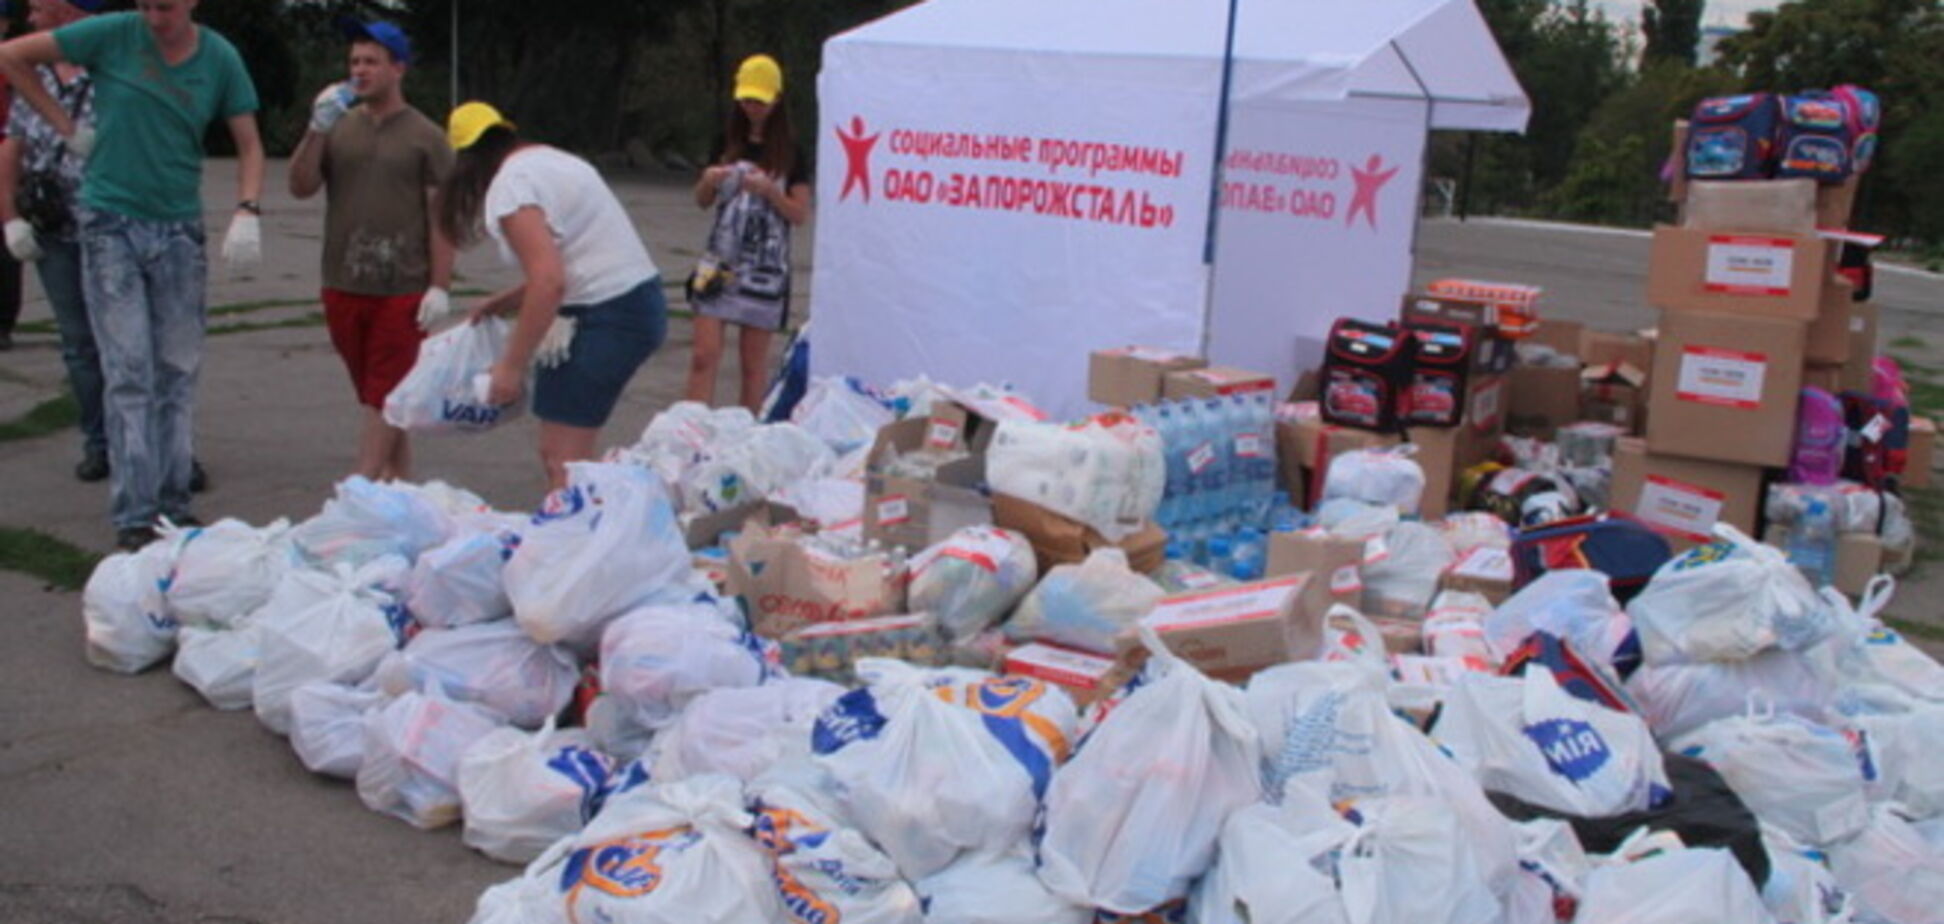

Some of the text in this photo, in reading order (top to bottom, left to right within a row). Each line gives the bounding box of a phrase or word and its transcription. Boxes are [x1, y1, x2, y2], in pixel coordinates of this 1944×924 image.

[888, 128, 1184, 178] социальные программы
[883, 168, 1174, 228] ОАО «ЗАПОРОЖСТАЛЬ»
